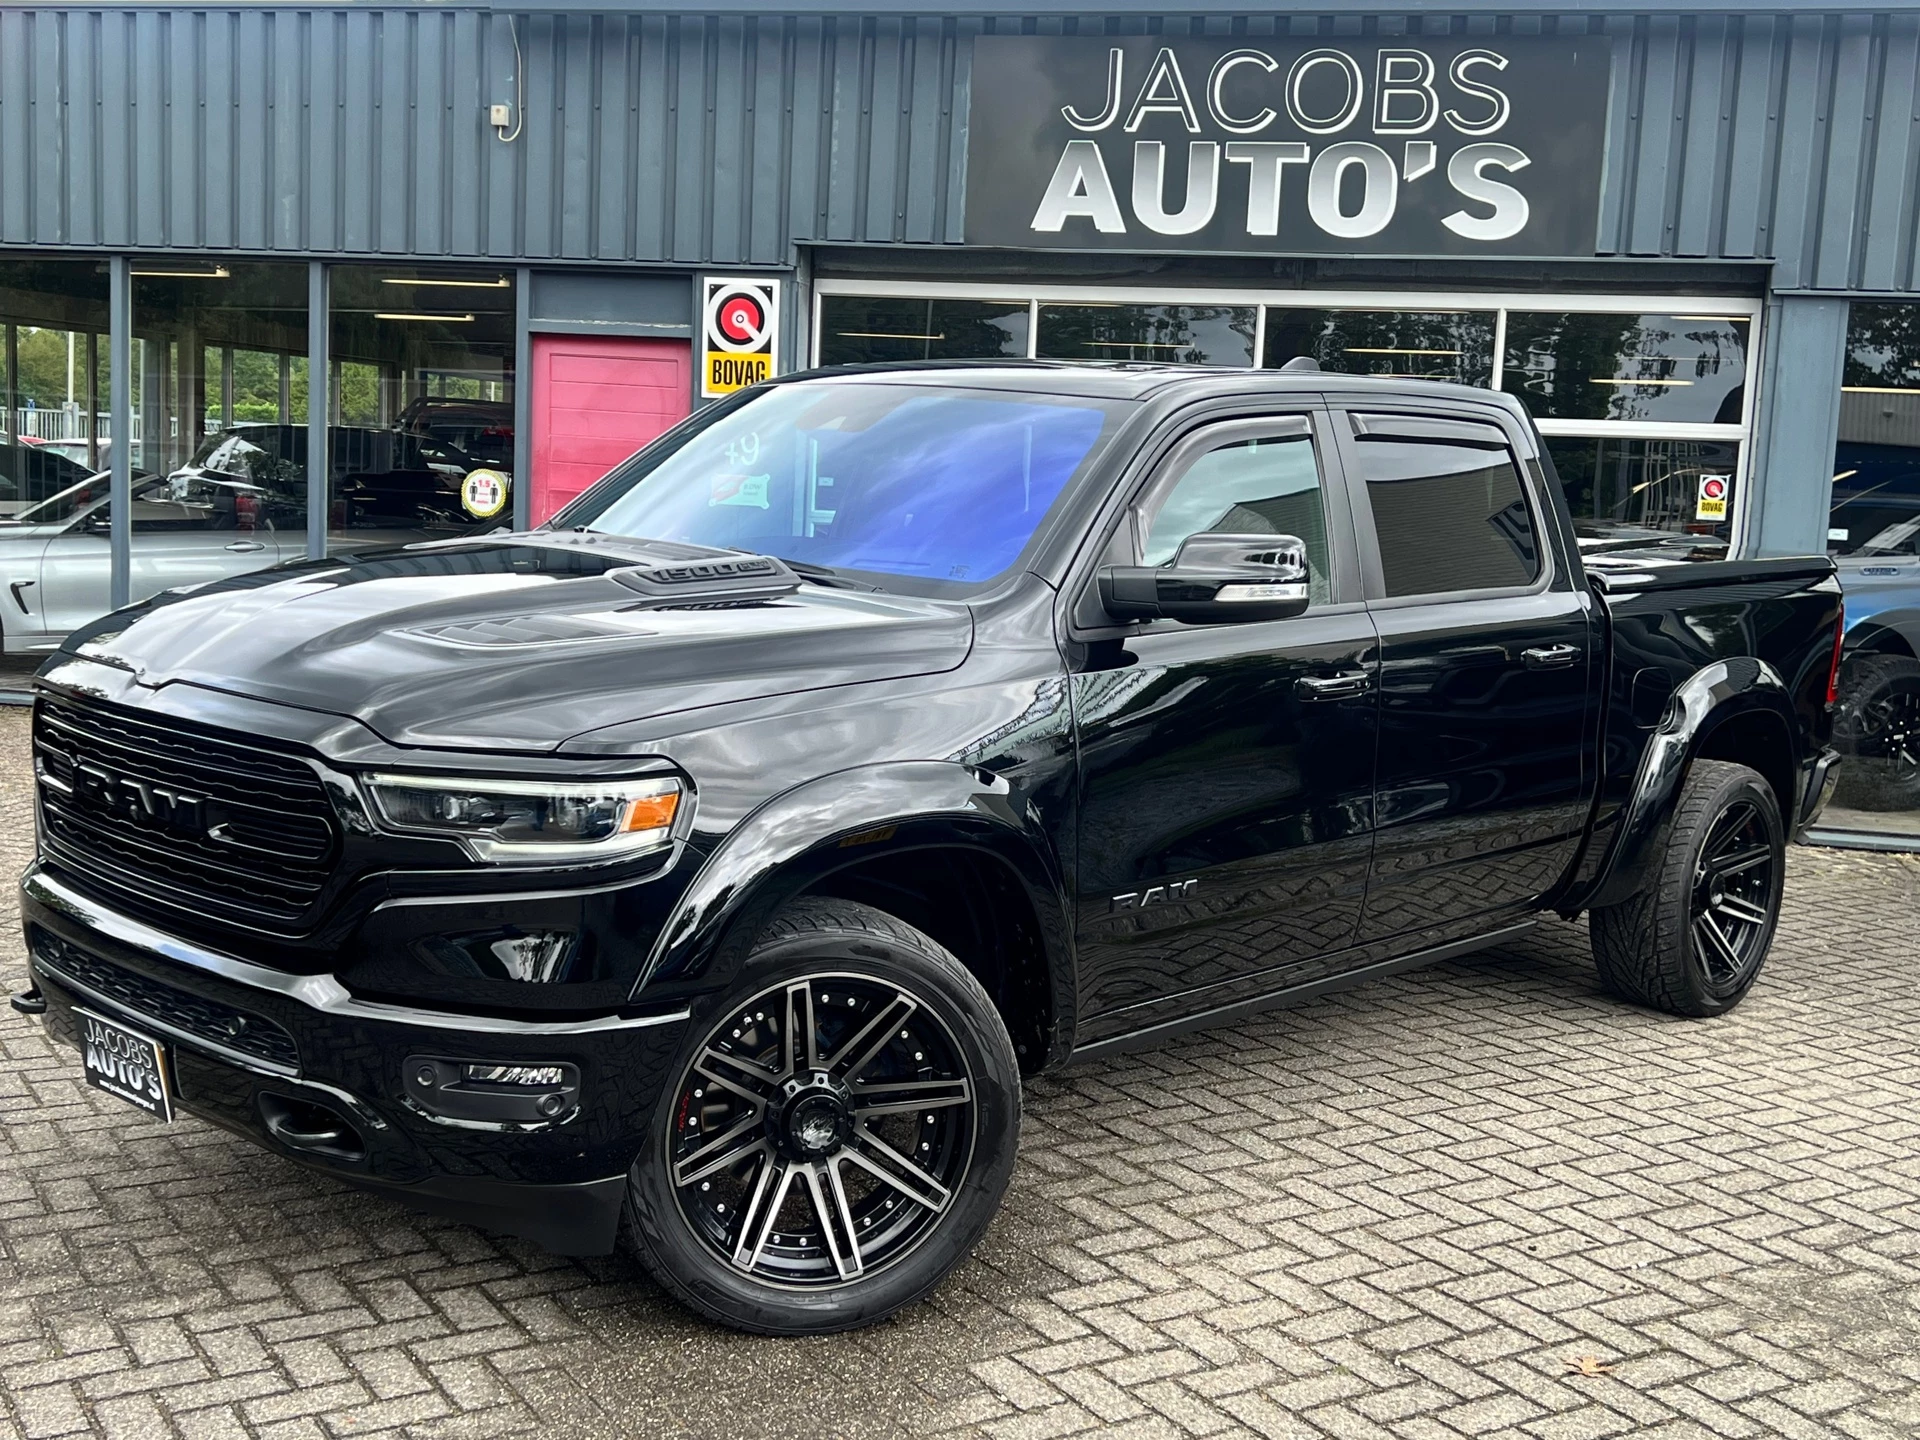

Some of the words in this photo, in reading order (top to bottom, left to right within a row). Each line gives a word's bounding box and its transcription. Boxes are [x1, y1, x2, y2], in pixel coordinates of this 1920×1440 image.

[1061, 48, 1510, 135] JACOBS
[1030, 140, 1532, 241] AUTO'S
[712, 359, 766, 386] BOVAG
[1702, 502, 1723, 512] BOVAG
[652, 564, 739, 581] 1500
[1109, 879, 1198, 914] RAM
[84, 1019, 153, 1069] JACOBS
[87, 1042, 162, 1100] AUTO'S
